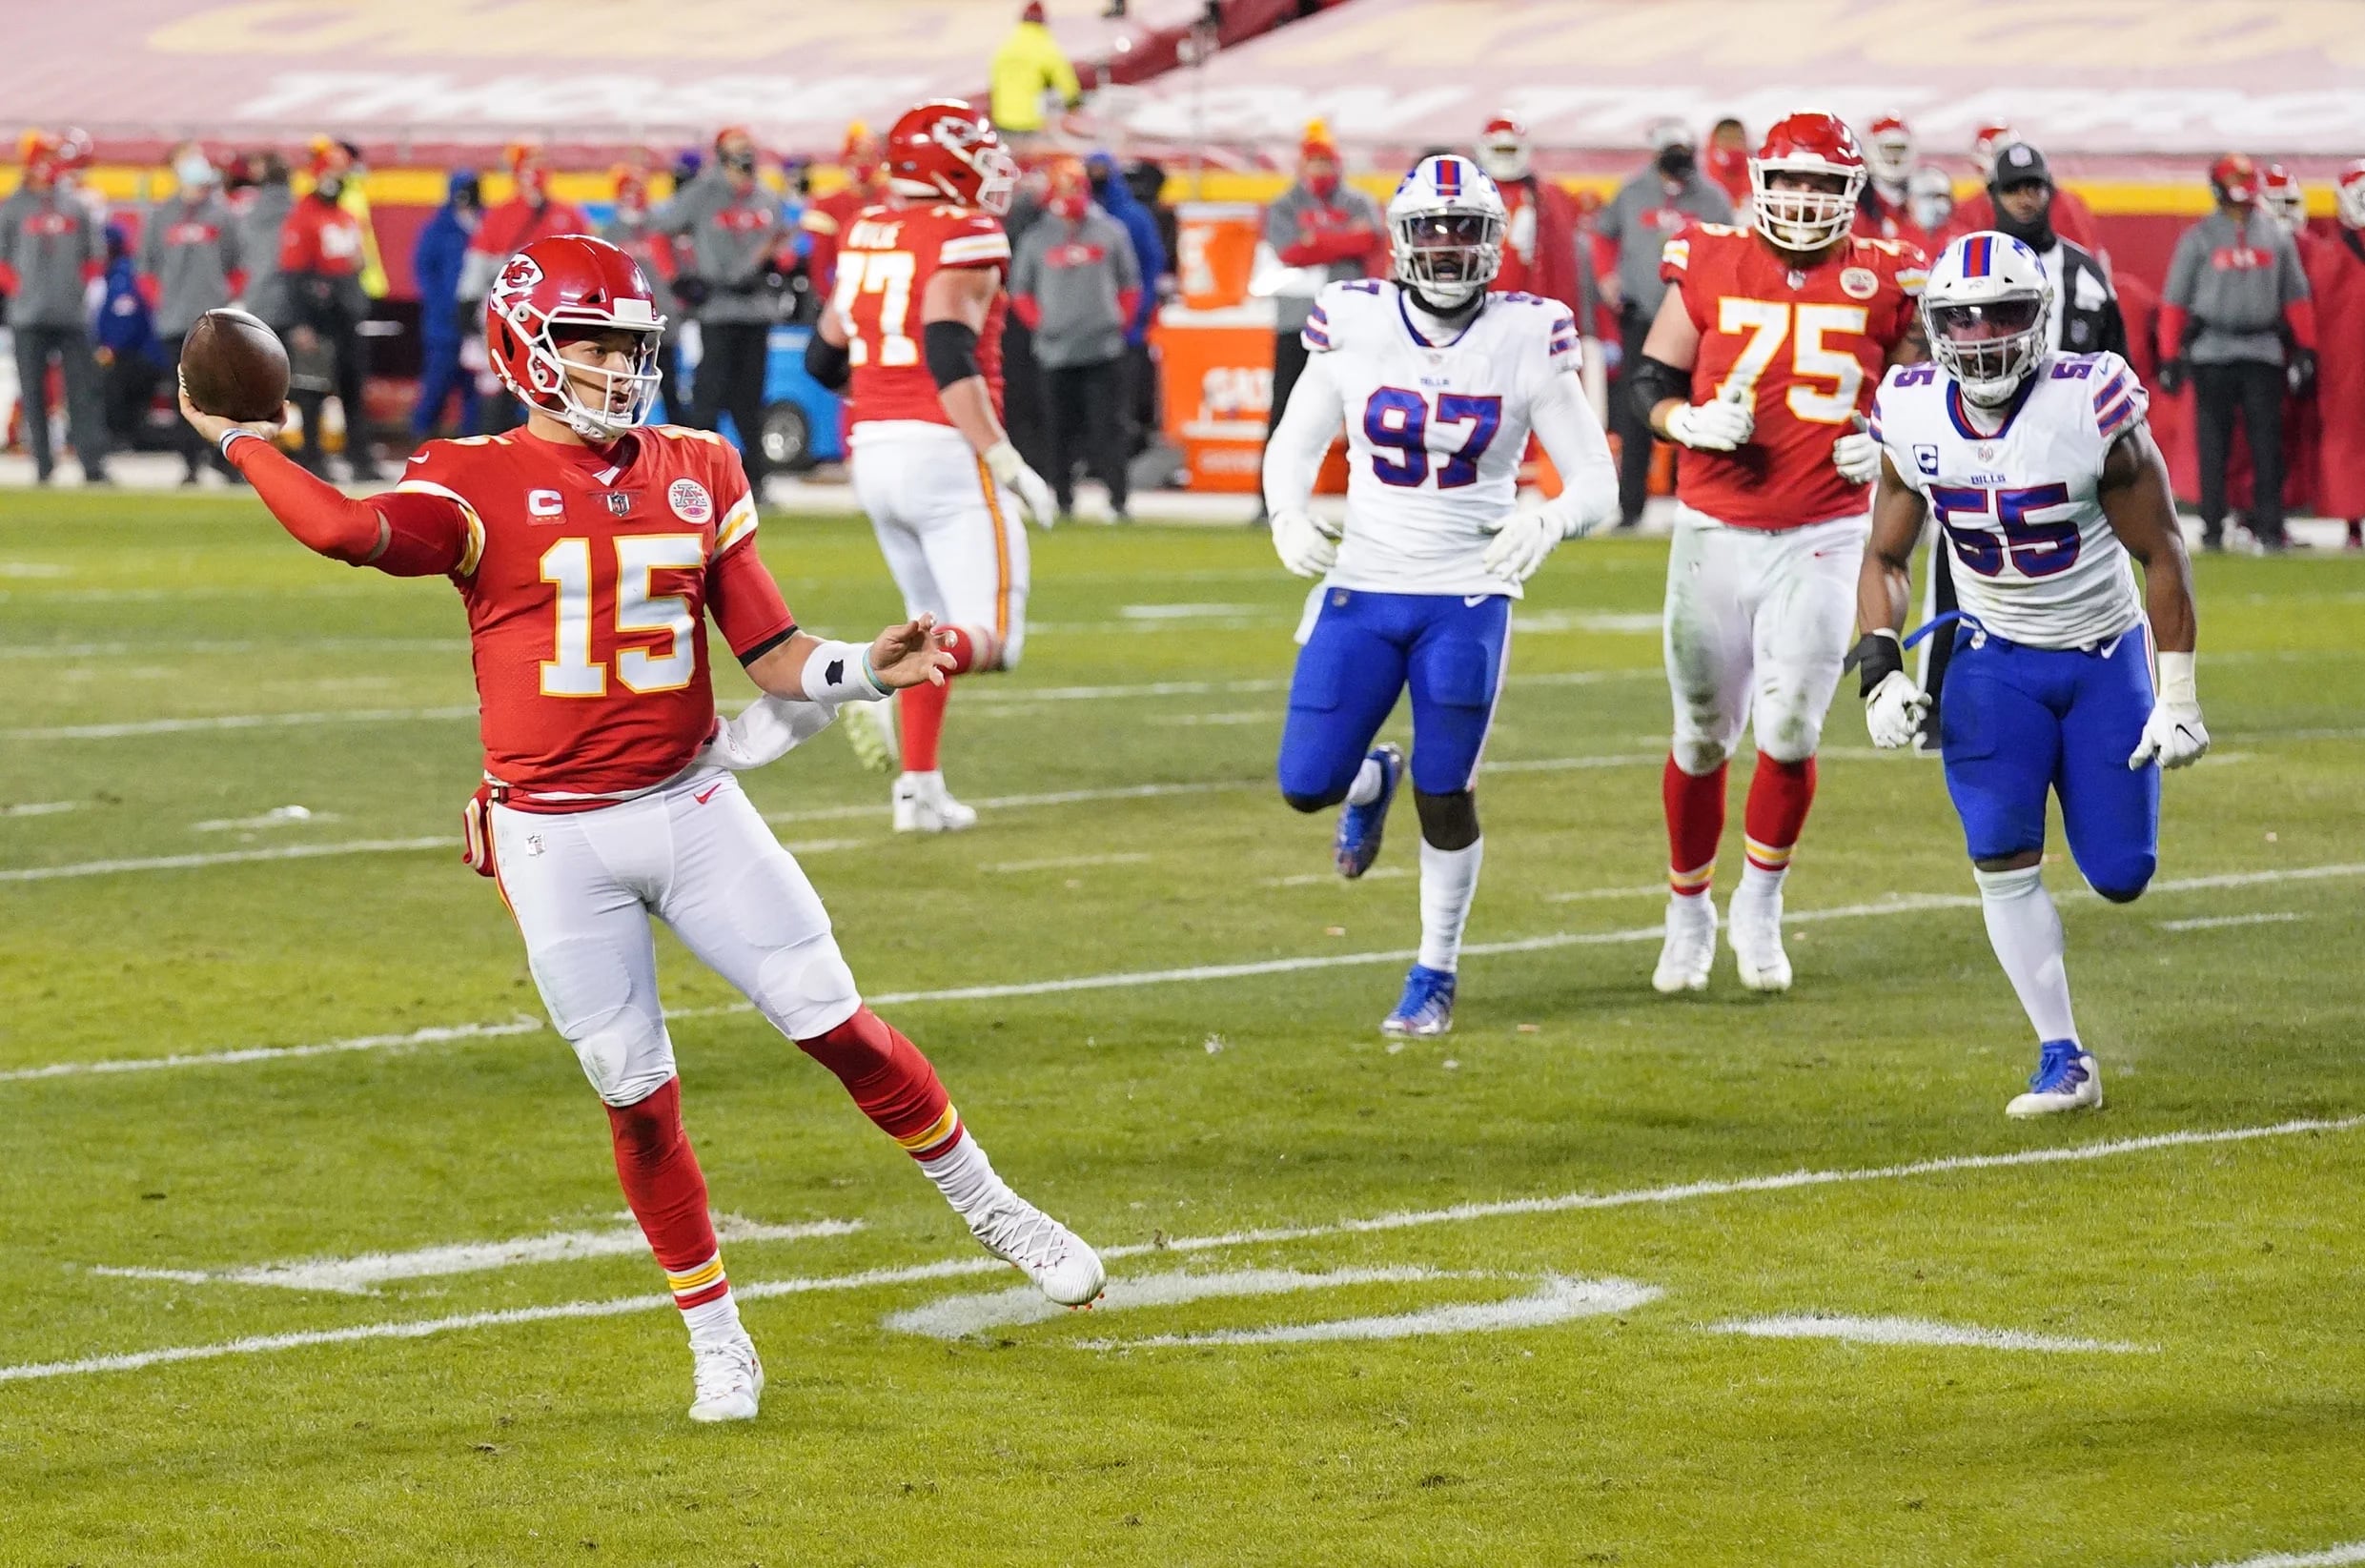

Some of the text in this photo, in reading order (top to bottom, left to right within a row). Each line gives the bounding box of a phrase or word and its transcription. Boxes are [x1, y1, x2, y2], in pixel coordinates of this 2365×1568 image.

[835, 251, 918, 366] 77
[1716, 296, 1868, 425] 75
[1364, 386, 1502, 489] 97
[528, 489, 564, 517] C
[1928, 482, 2081, 578] 55
[540, 533, 703, 698] 15
